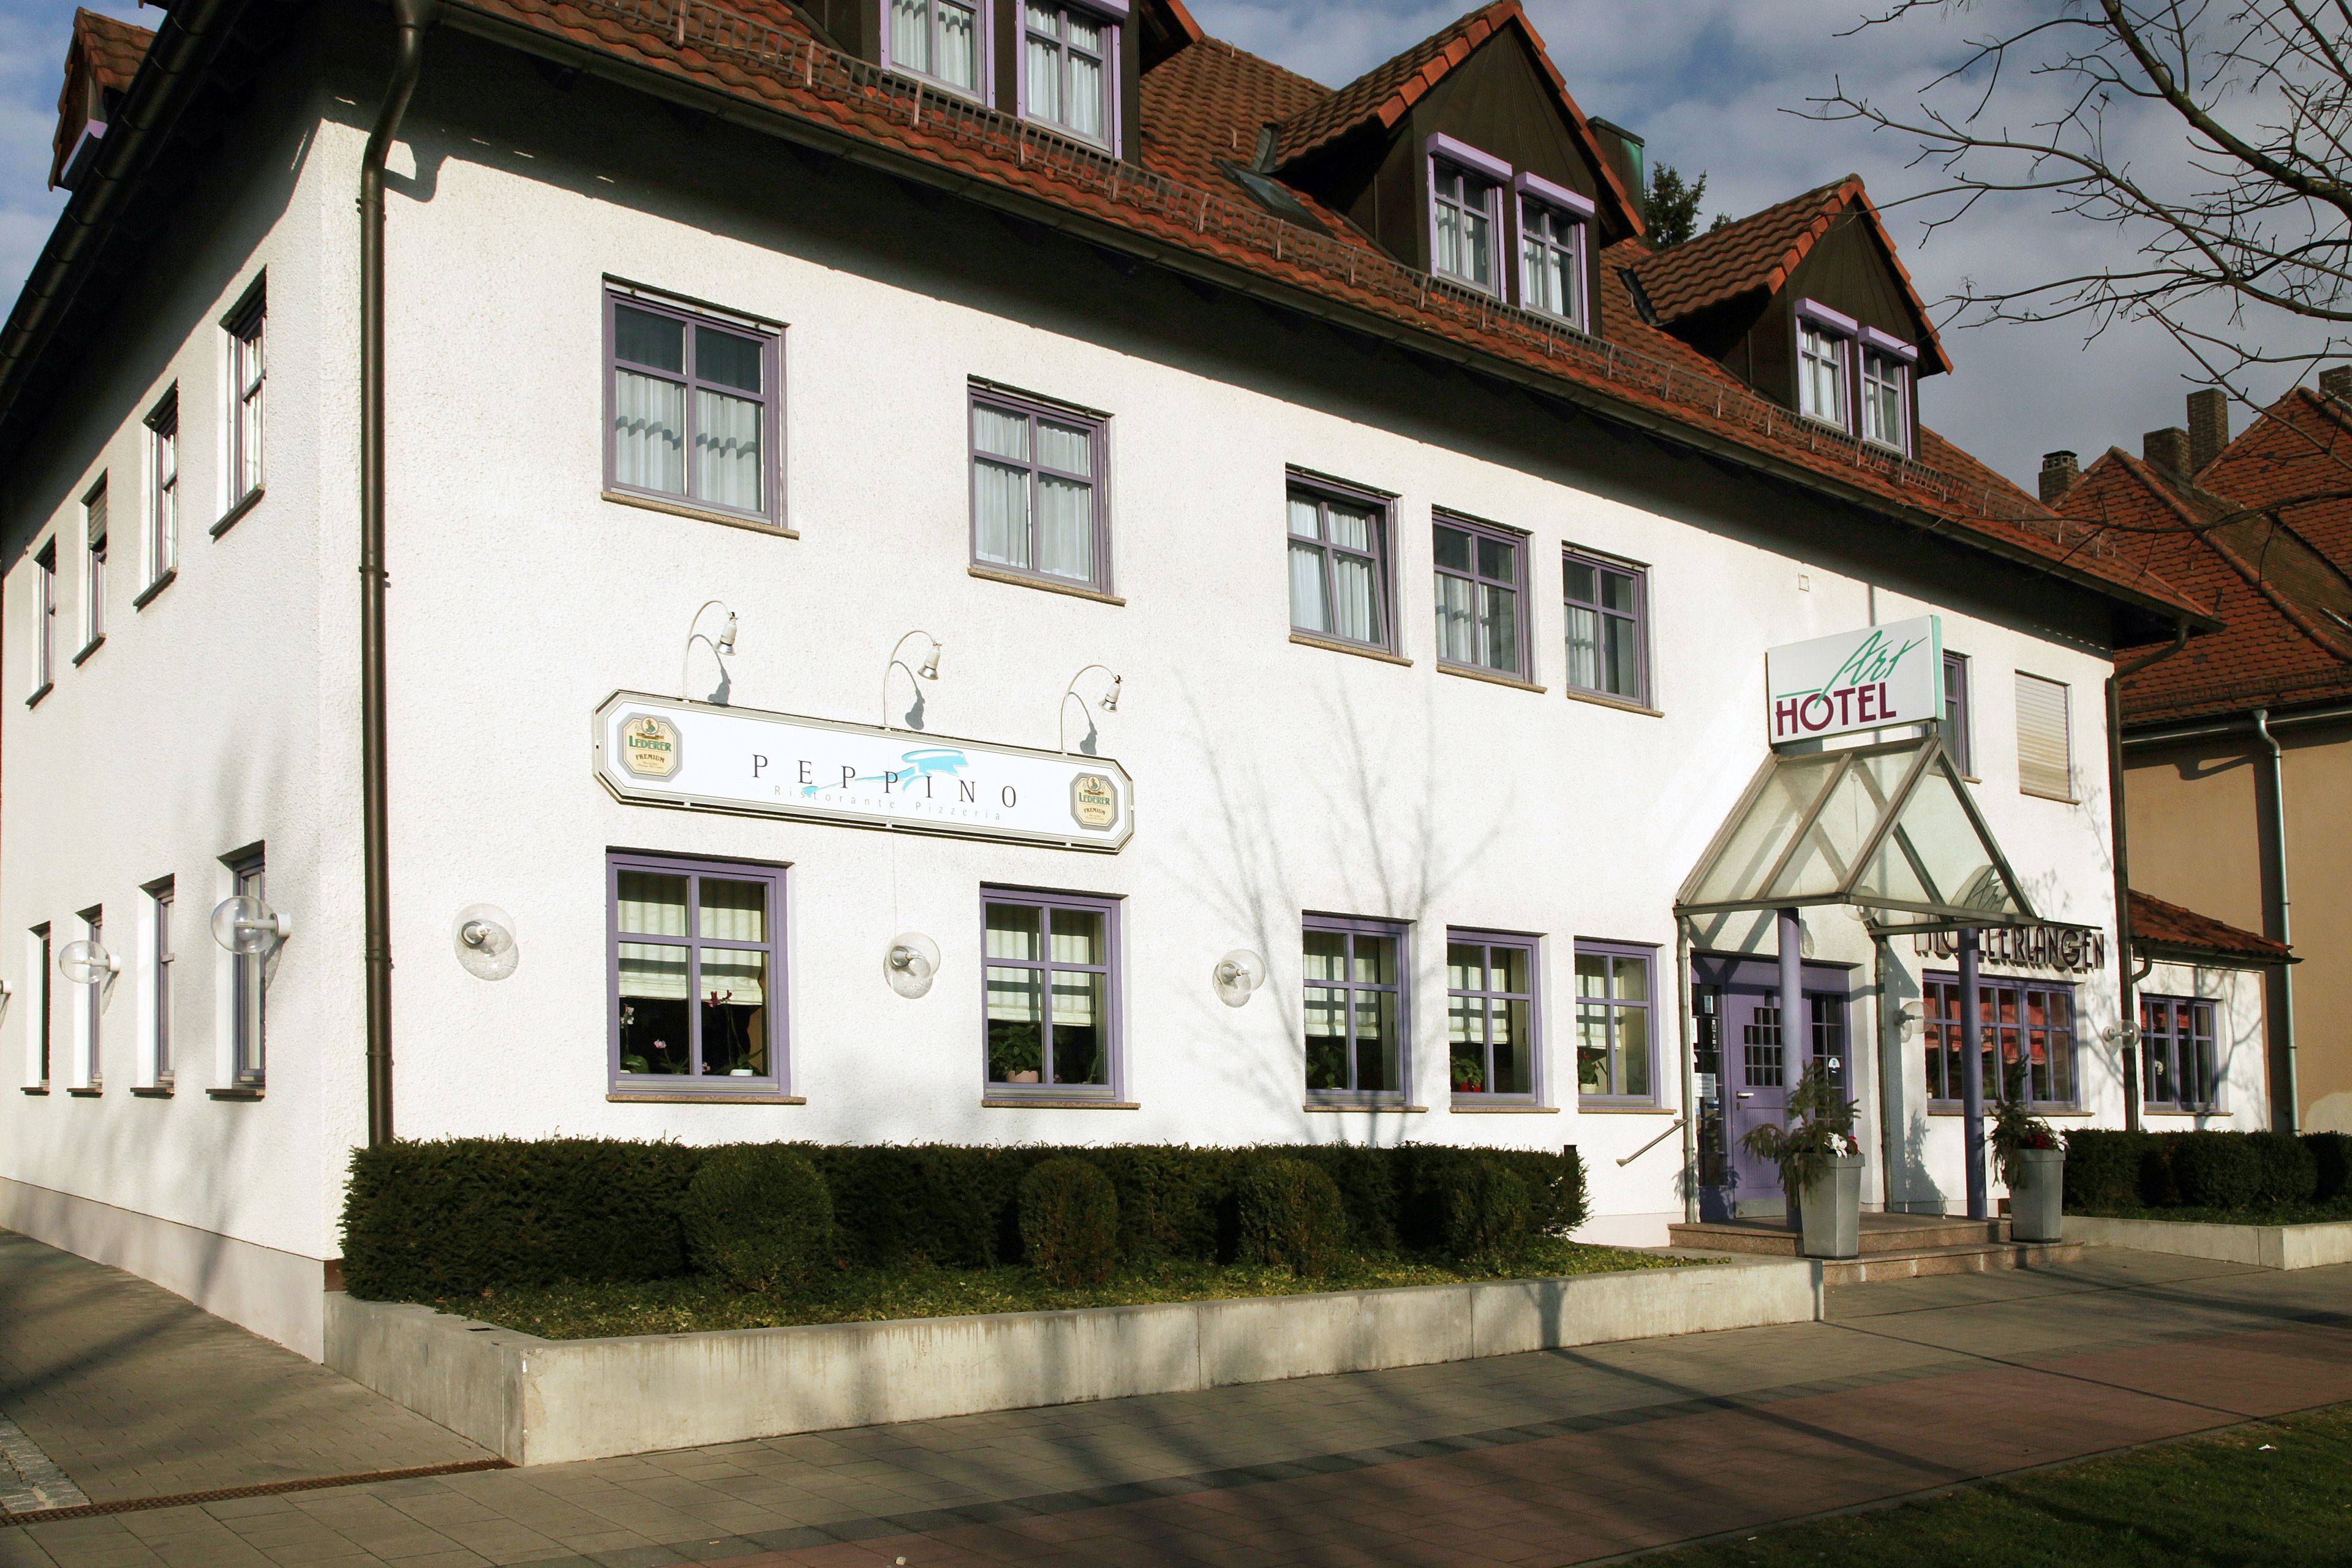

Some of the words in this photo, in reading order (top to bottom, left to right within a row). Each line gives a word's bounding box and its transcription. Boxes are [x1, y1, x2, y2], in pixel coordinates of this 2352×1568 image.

[1815, 630, 1928, 686] Art
[1776, 682, 1897, 737] HOTEL
[629, 735, 672, 752] LEDERER
[635, 753, 665, 763] PREMIUM
[752, 754, 1016, 808] PEPPINO
[1079, 792, 1110, 806] LEDERER
[774, 785, 895, 809] Ristorante
[915, 801, 1000, 821] Pizzeria
